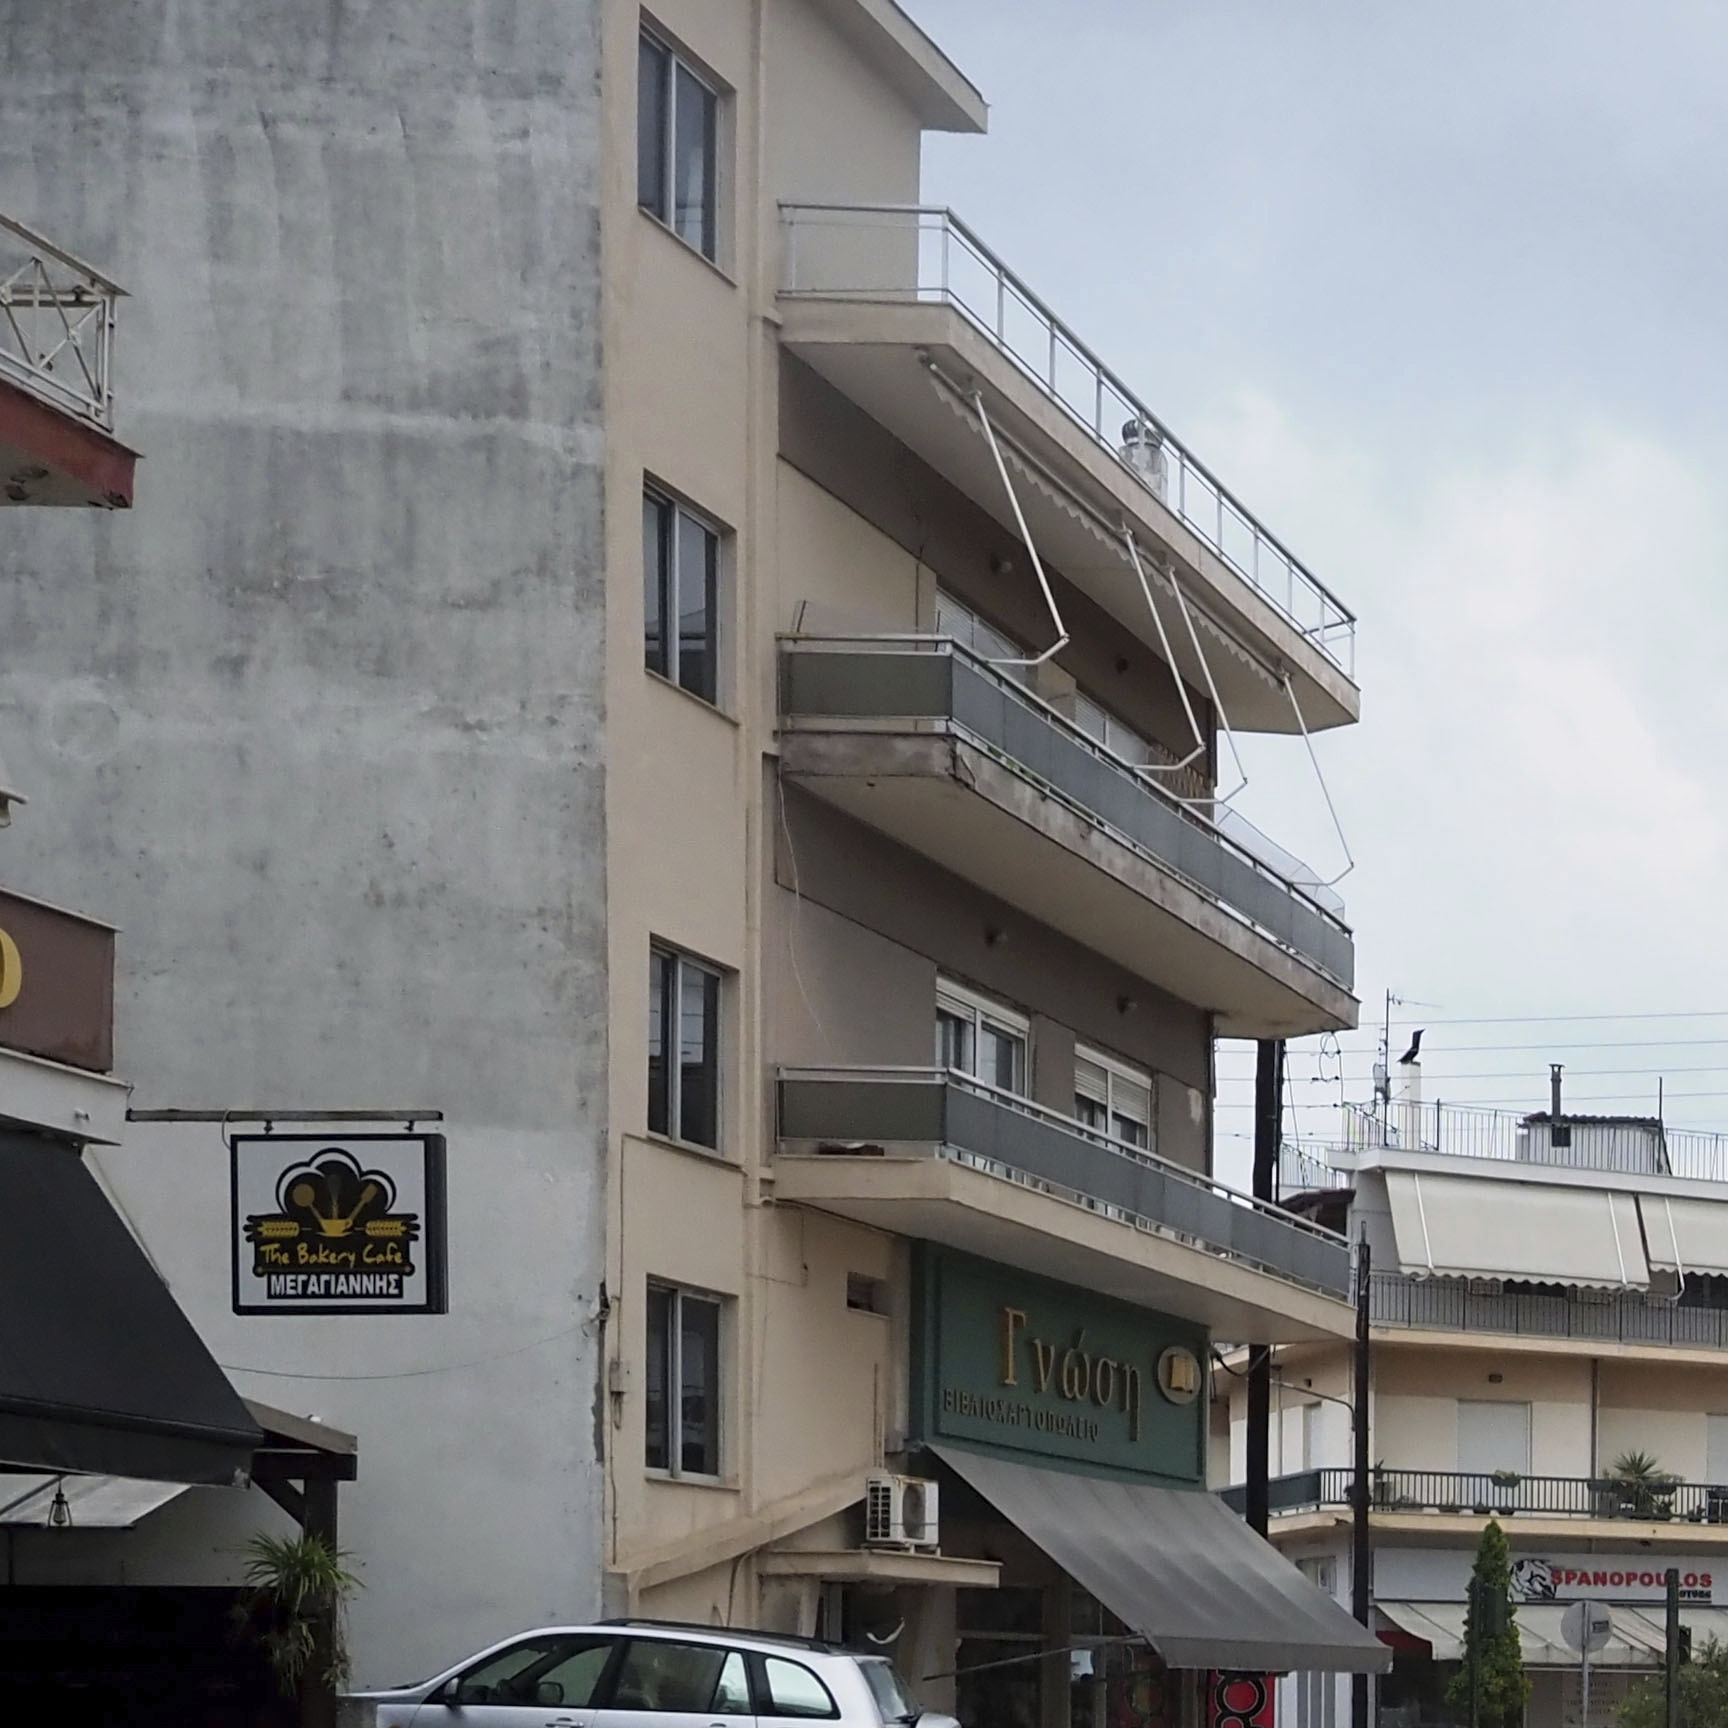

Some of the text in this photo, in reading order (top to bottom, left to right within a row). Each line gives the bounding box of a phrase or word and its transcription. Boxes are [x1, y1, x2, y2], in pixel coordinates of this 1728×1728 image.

[260, 1242, 402, 1268] The Bakery Cafe
[270, 1275, 399, 1295] ΜΕΓΑΓΙΑΝΝΗΣ
[1004, 1307, 1141, 1442] Γνώση
[1551, 1570, 1712, 1588] SPANOPOUOS
